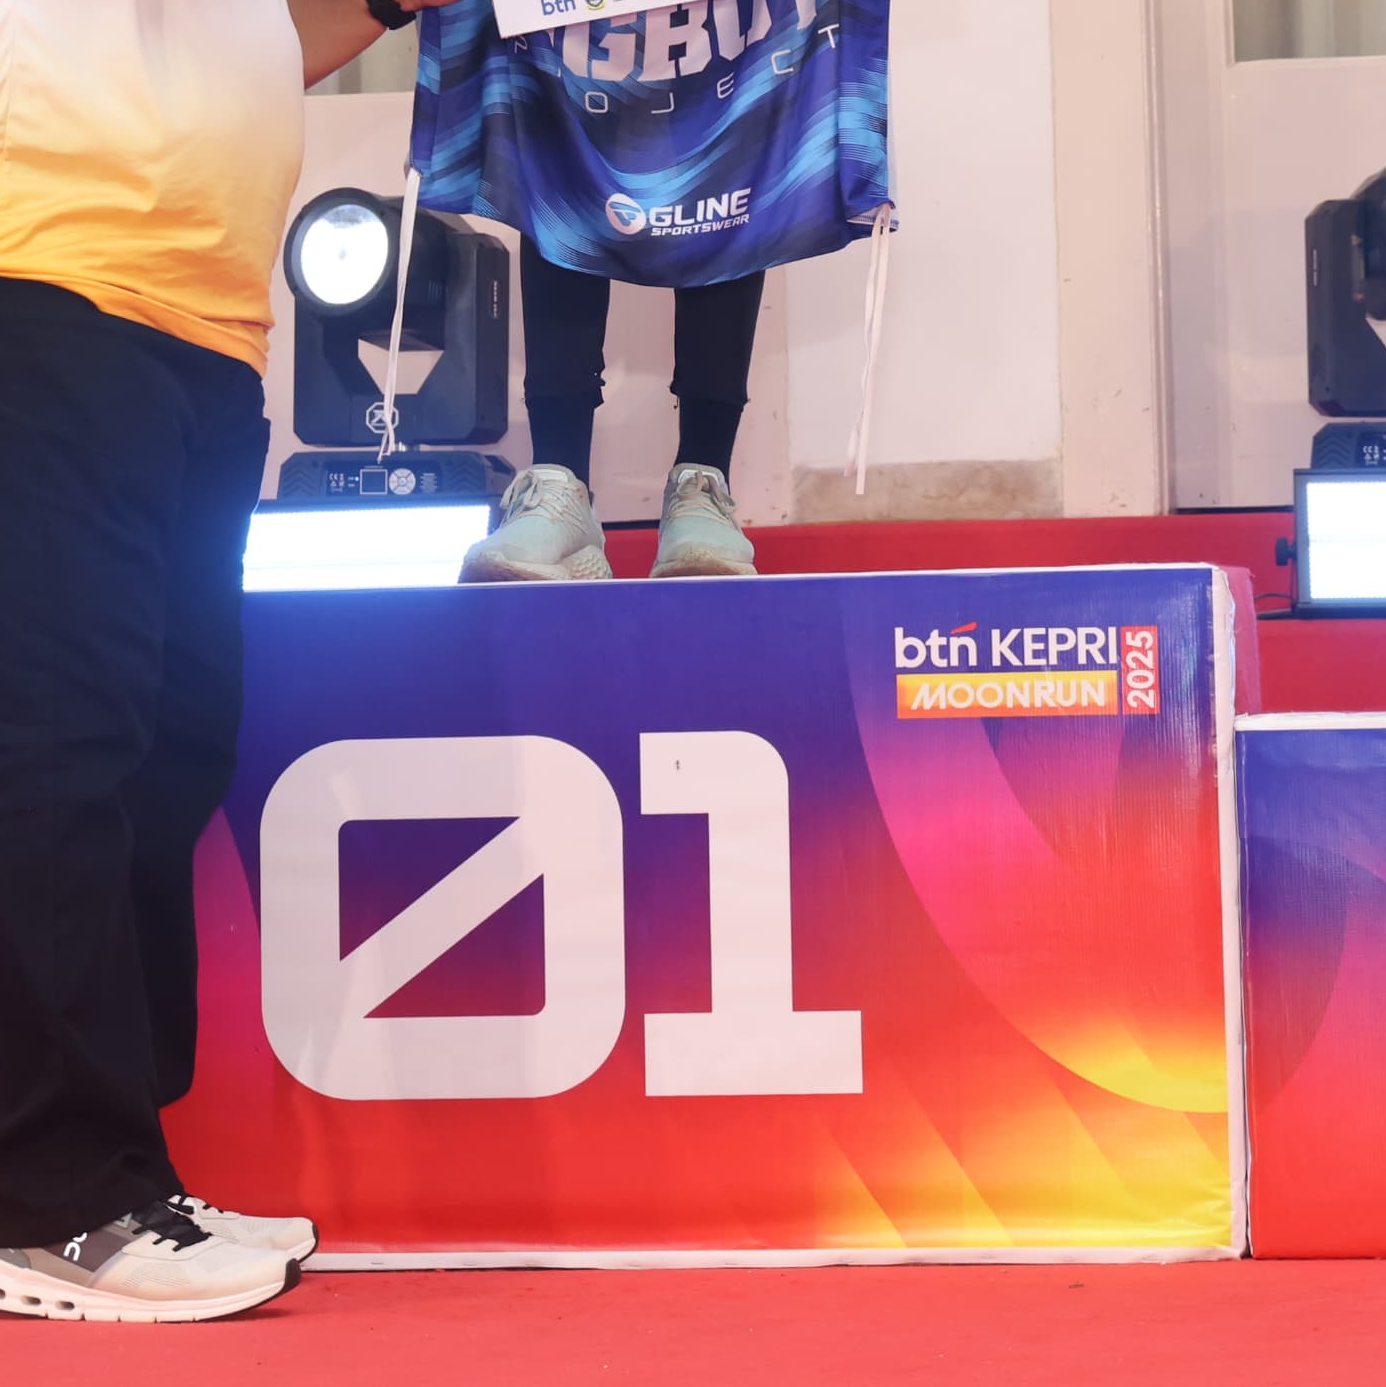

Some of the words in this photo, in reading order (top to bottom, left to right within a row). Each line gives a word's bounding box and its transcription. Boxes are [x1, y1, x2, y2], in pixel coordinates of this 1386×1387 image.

[649, 188, 751, 227] GLINE
[650, 213, 751, 236] SPORTSWEAR
[894, 621, 978, 668] btn
[991, 626, 1118, 667] KEPRI
[1124, 630, 1155, 708] 2025
[911, 678, 1106, 710] MOONRUN
[260, 730, 864, 1101] 01
